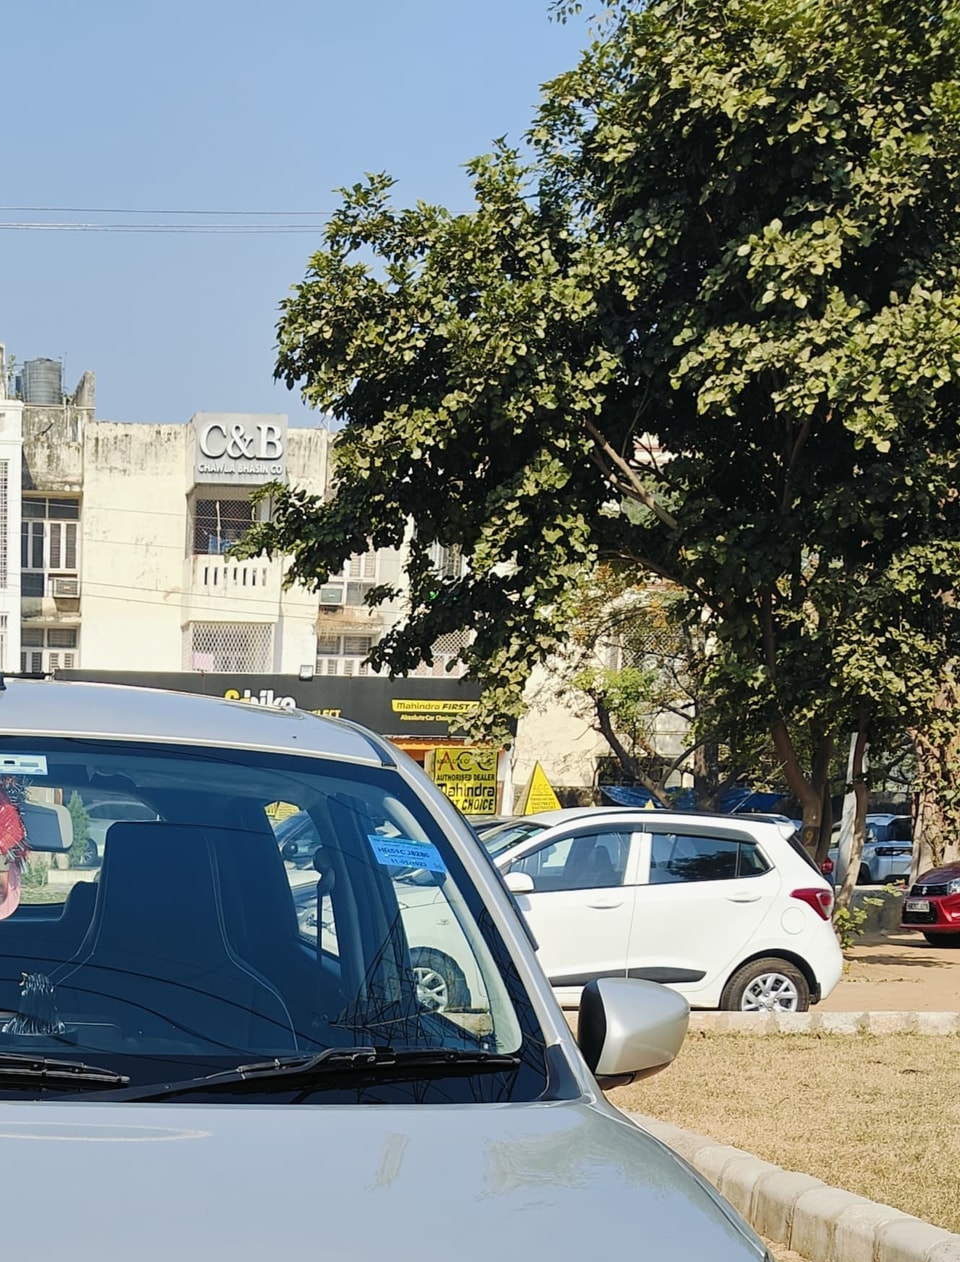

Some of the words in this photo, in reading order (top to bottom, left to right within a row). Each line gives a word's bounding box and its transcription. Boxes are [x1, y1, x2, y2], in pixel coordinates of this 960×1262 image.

[200, 424, 284, 461] C&B
[198, 464, 235, 475] CHAWLA
[270, 465, 283, 475] CO
[396, 702, 440, 710] Mahindra
[442, 703, 470, 711] FIRST
[461, 799, 494, 811] CHOICE
